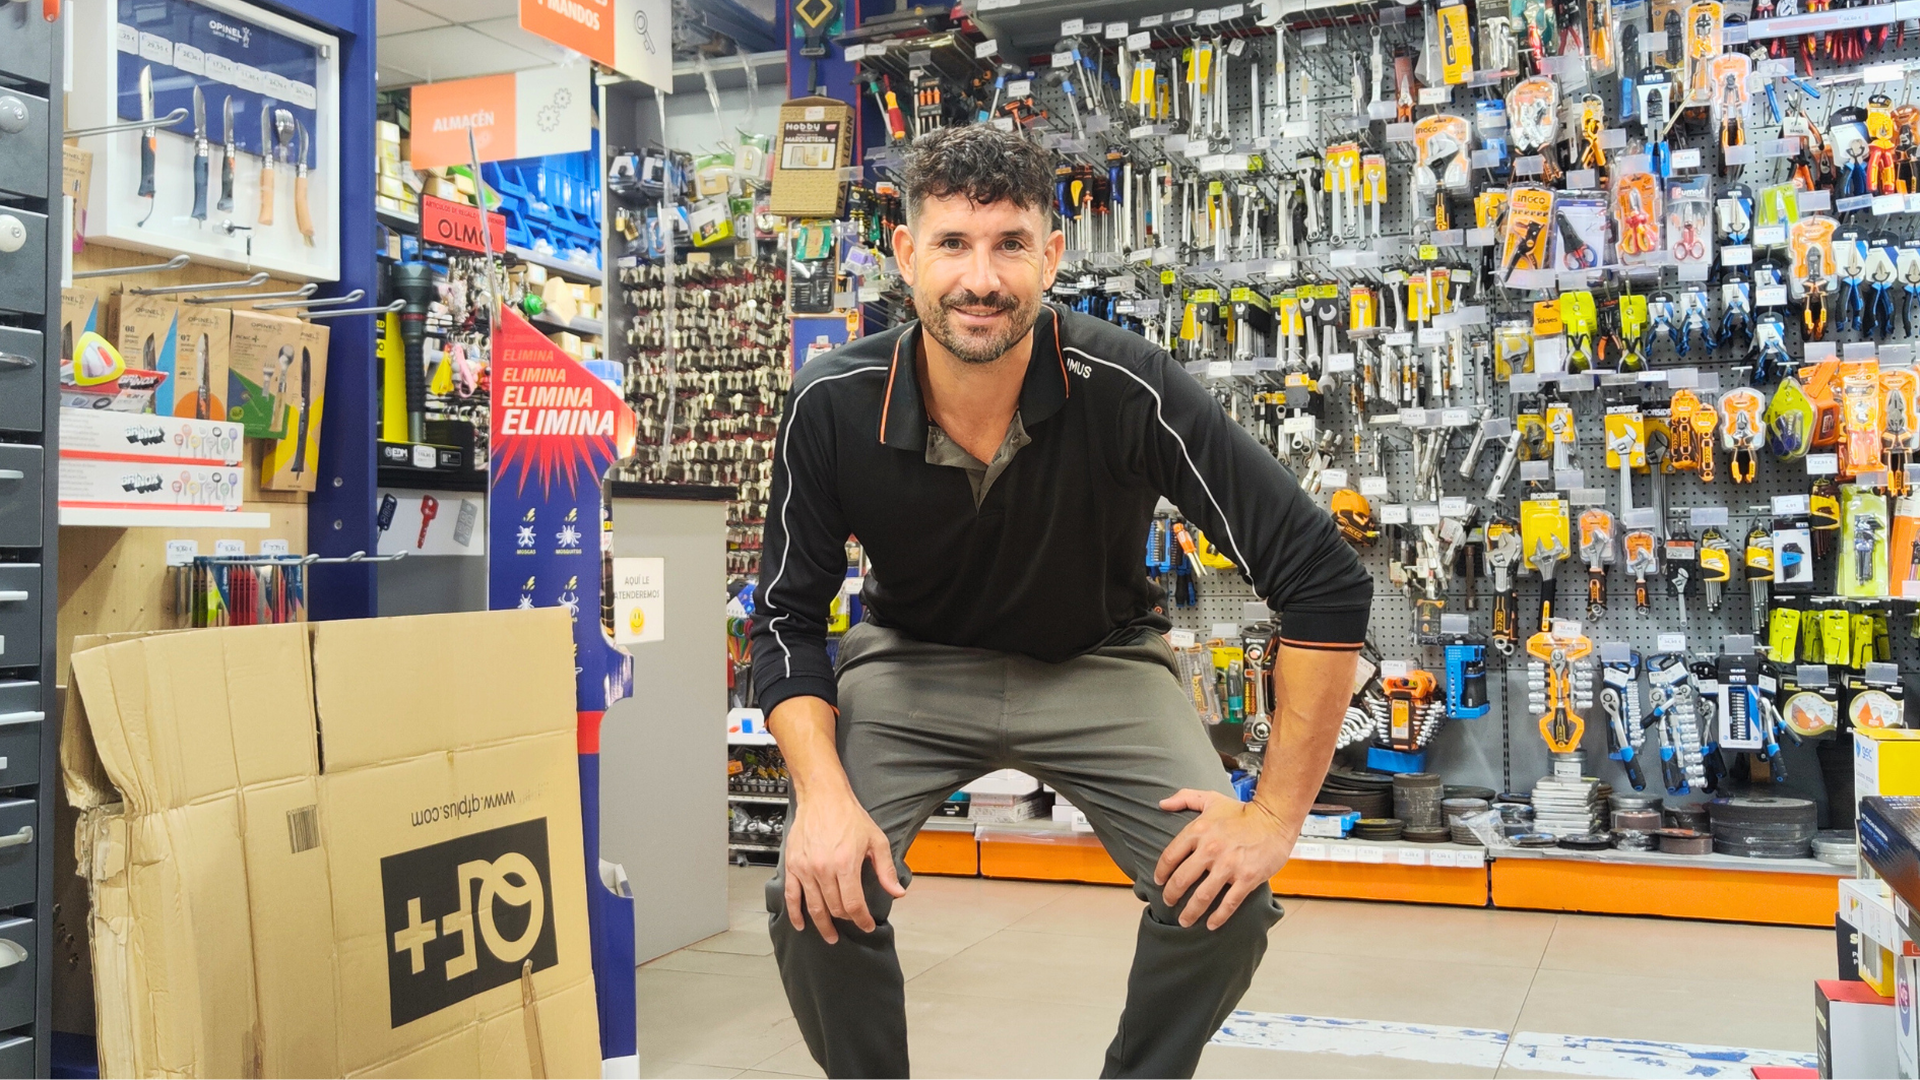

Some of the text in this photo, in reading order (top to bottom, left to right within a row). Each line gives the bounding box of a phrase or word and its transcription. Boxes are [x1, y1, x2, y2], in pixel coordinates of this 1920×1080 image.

[209, 20, 242, 39] OPINEL
[433, 110, 494, 132] ALMACÉN
[785, 123, 820, 132] Hobby
[844, 116, 854, 158] LEARN
[1517, 195, 1546, 206] INGCO
[502, 349, 554, 361] ELIMINA
[119, 374, 158, 389] BRINOX
[502, 367, 566, 383] ELIMINA
[501, 386, 593, 408] ELIMINA
[501, 408, 614, 436] ELIMINA
[125, 424, 166, 444] BRINOX
[121, 472, 163, 493] BRINOX
[624, 574, 650, 586] AQUÍ LE
[614, 590, 660, 600] ATENDEREMOS
[410, 790, 516, 828] www.qfplus.com
